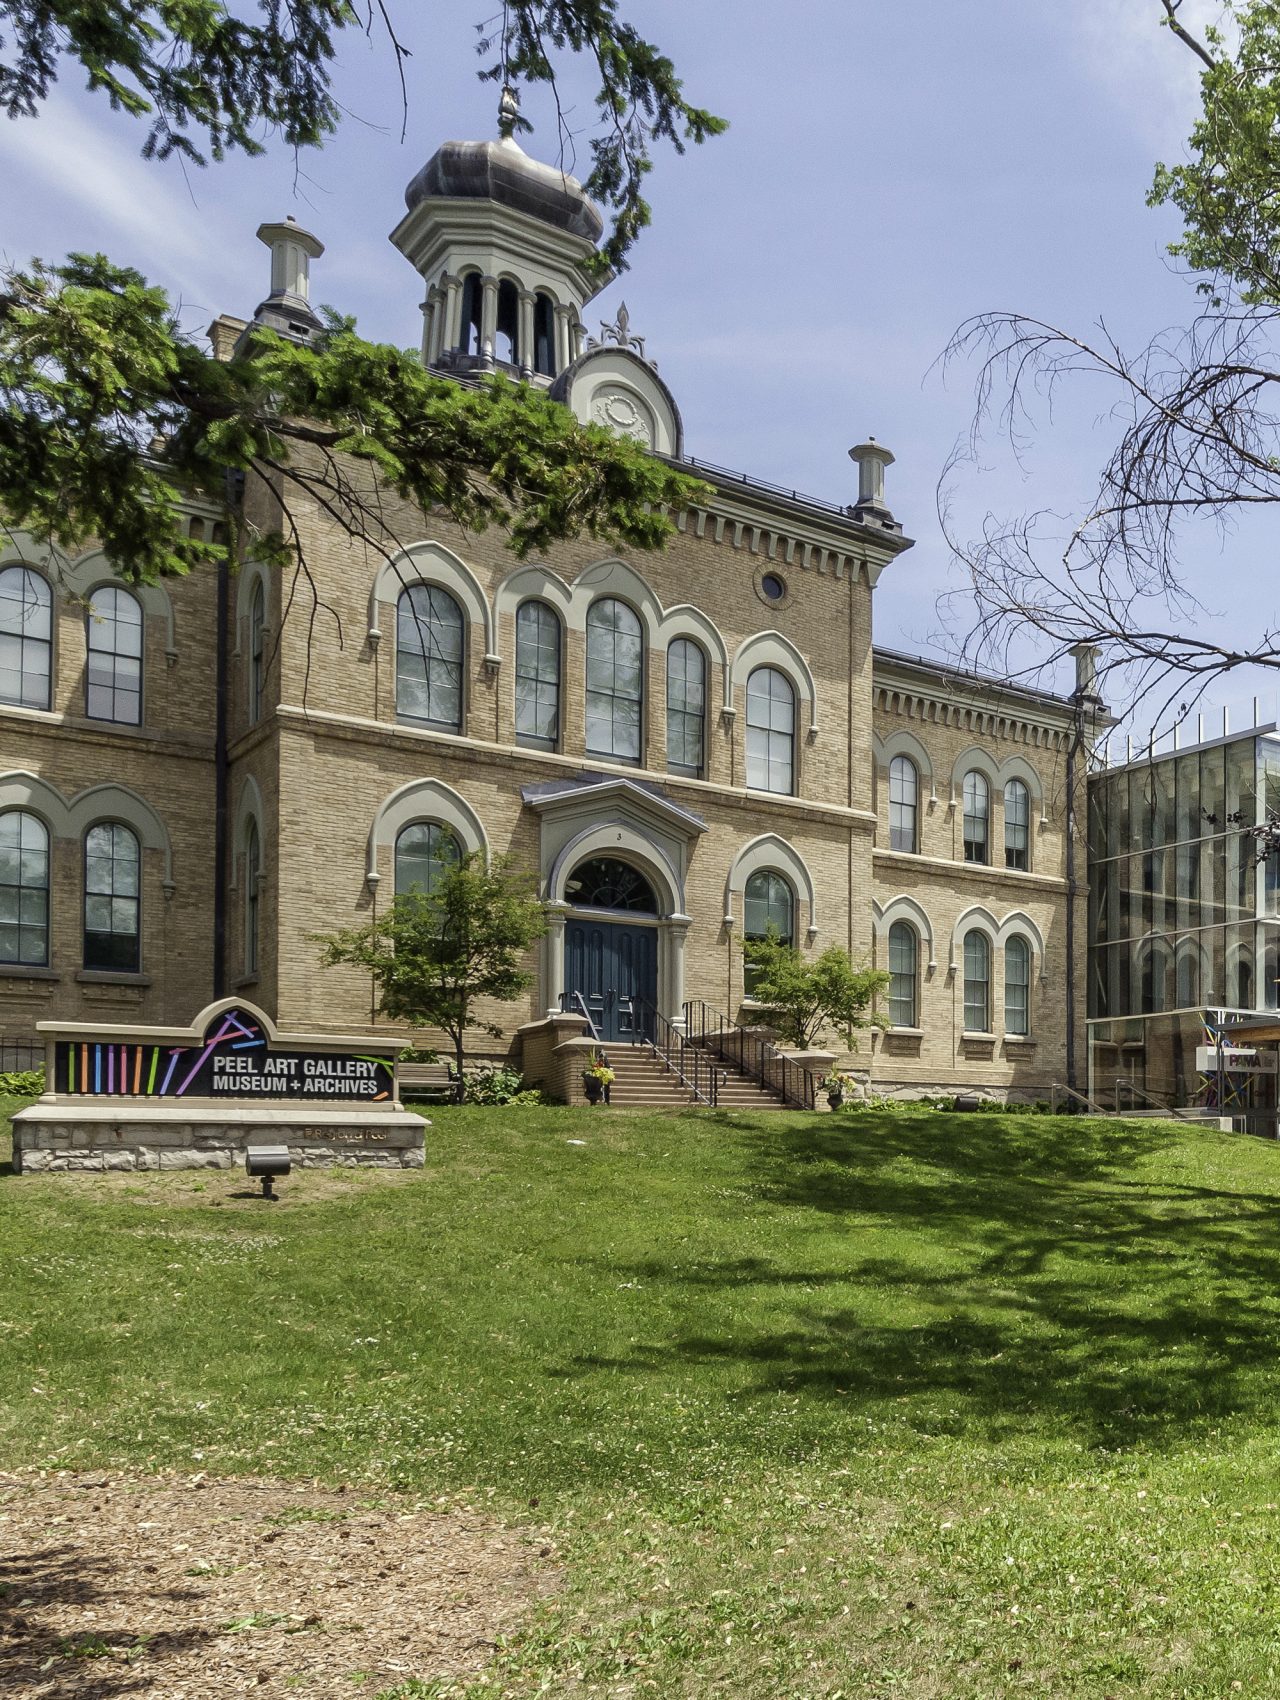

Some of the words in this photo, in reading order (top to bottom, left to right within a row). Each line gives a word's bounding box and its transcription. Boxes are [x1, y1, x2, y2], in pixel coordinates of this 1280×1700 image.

[213, 1056, 258, 1073] PEEL
[264, 1058, 299, 1075] ART
[303, 1060, 378, 1077] GALLERY
[213, 1075, 287, 1091] MUSEUM
[304, 1079, 378, 1094] ARCHIVES
